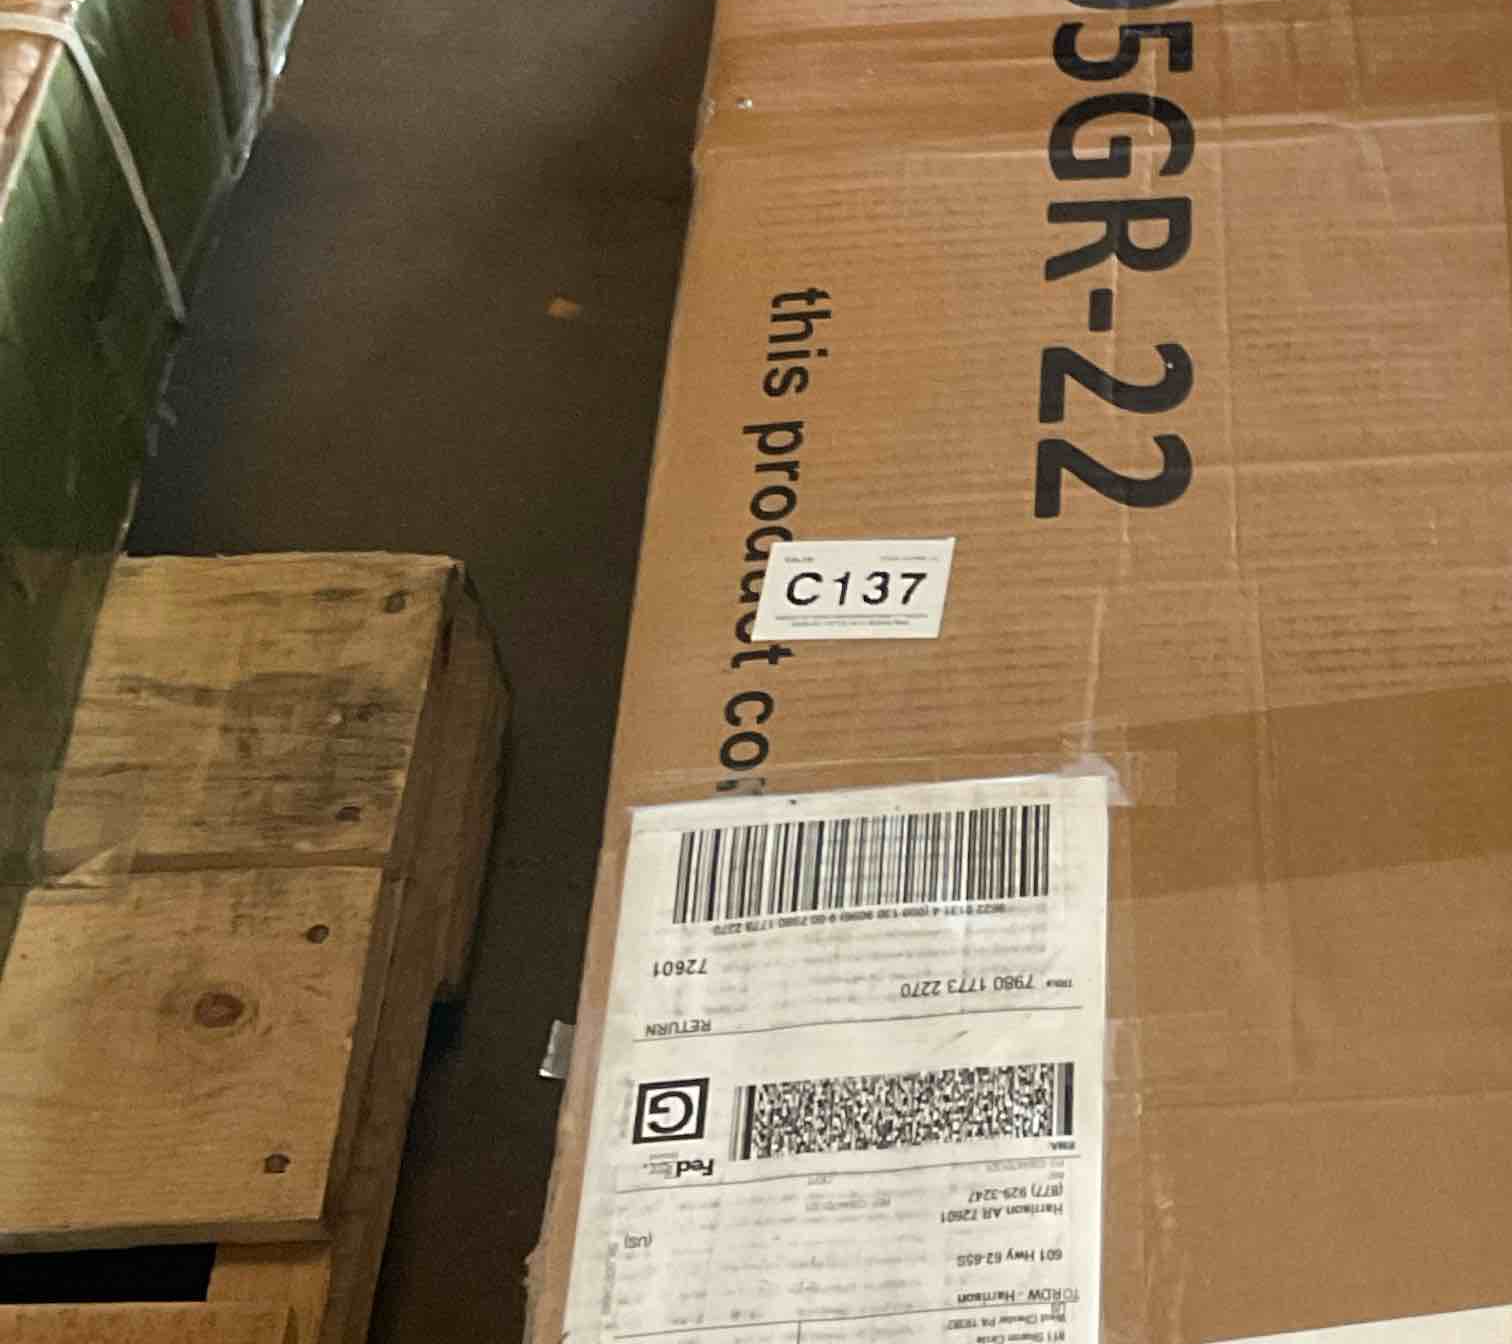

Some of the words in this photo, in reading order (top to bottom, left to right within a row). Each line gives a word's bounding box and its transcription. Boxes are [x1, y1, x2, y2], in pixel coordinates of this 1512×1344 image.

[763, 286, 831, 398] this
[785, 571, 928, 607] C137
[651, 958, 708, 976] 72601
[901, 981, 941, 997] 2270
[947, 978, 986, 993] 1773
[993, 975, 1034, 992] 7980
[645, 1018, 710, 1036] RETURN
[649, 1091, 694, 1134] G
[1007, 1202, 1063, 1215] Harrison
[1007, 1248, 1035, 1262] Hwy
[957, 1289, 1016, 1304] Harrison
